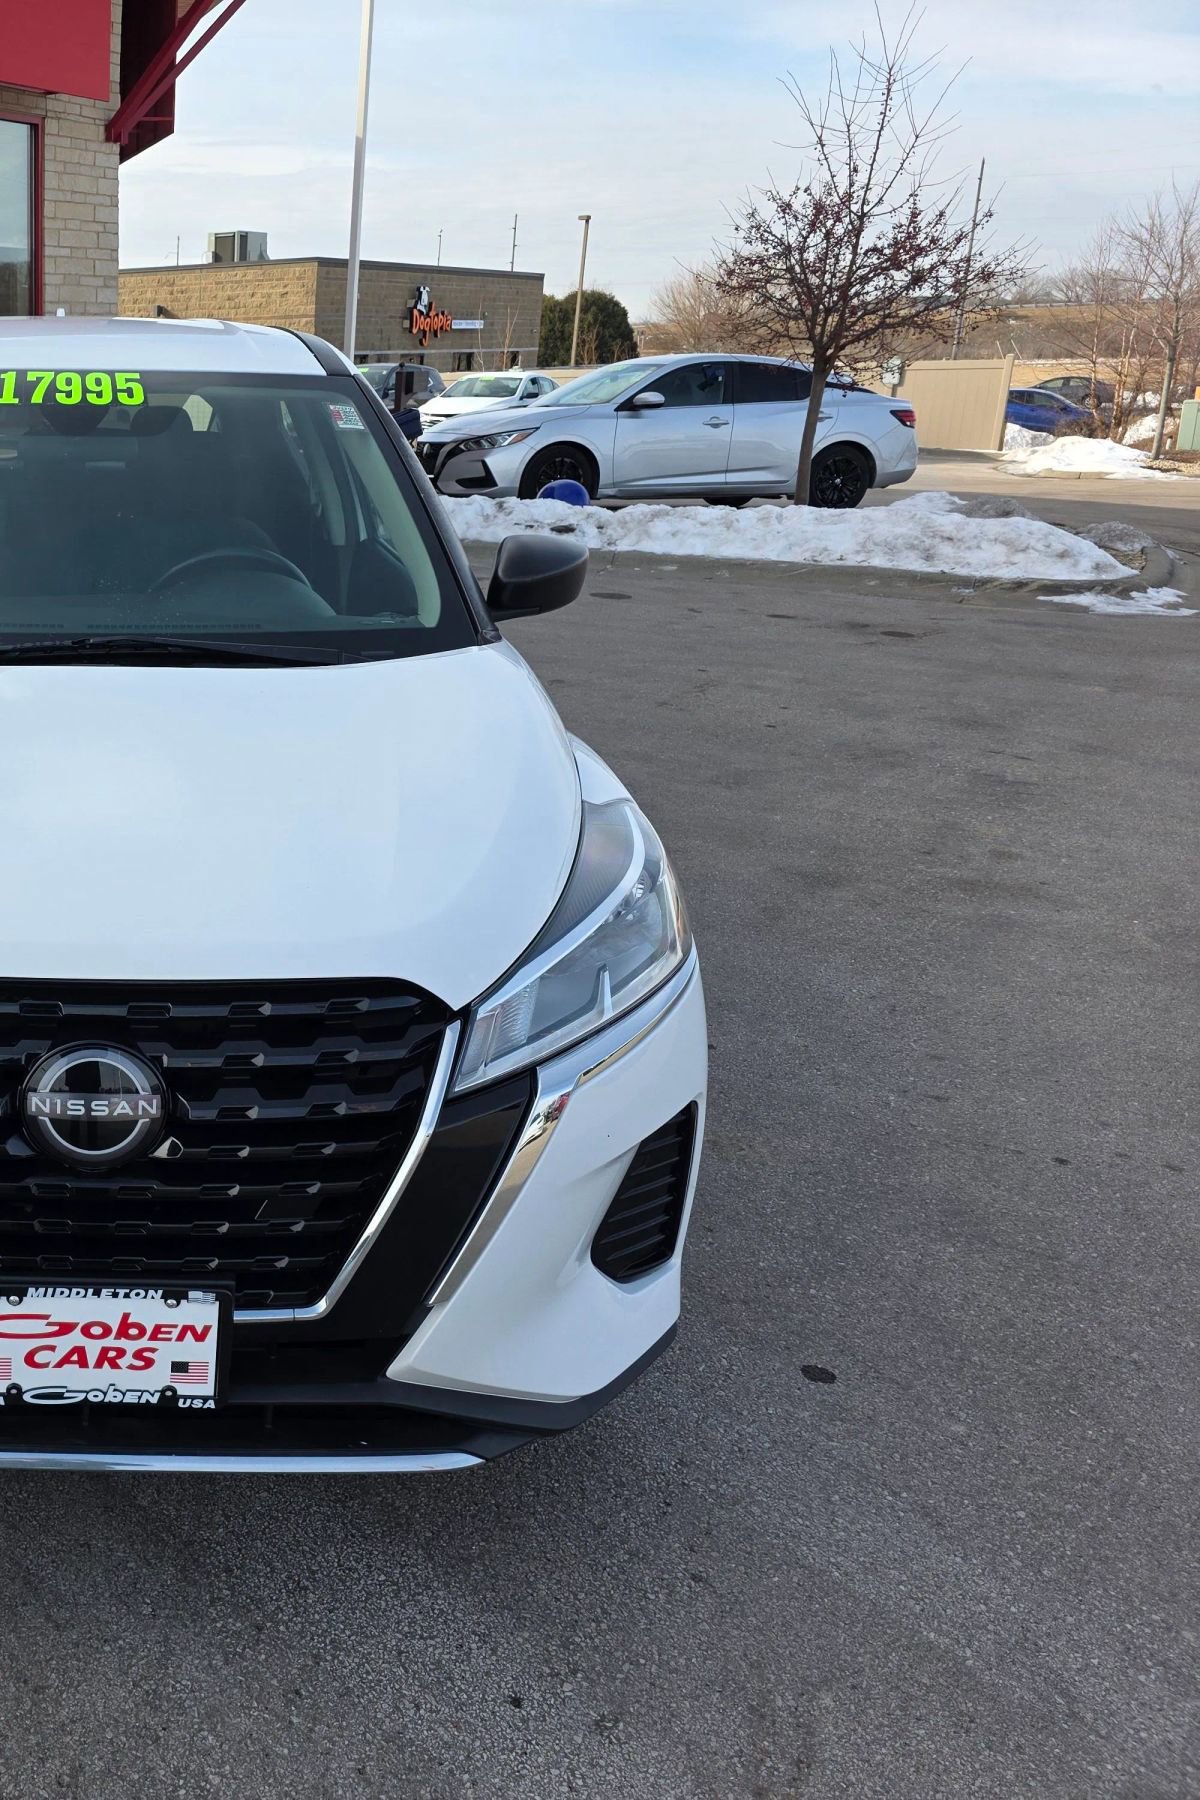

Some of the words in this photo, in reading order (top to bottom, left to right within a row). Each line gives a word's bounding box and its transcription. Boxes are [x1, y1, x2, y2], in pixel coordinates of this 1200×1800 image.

[412, 301, 452, 346] Dogtopia
[31, 1097, 157, 1116] NISSAN
[25, 1287, 163, 1300] MIDDLETON
[23, 1344, 160, 1371] CARS
[178, 1398, 216, 1409] USA
